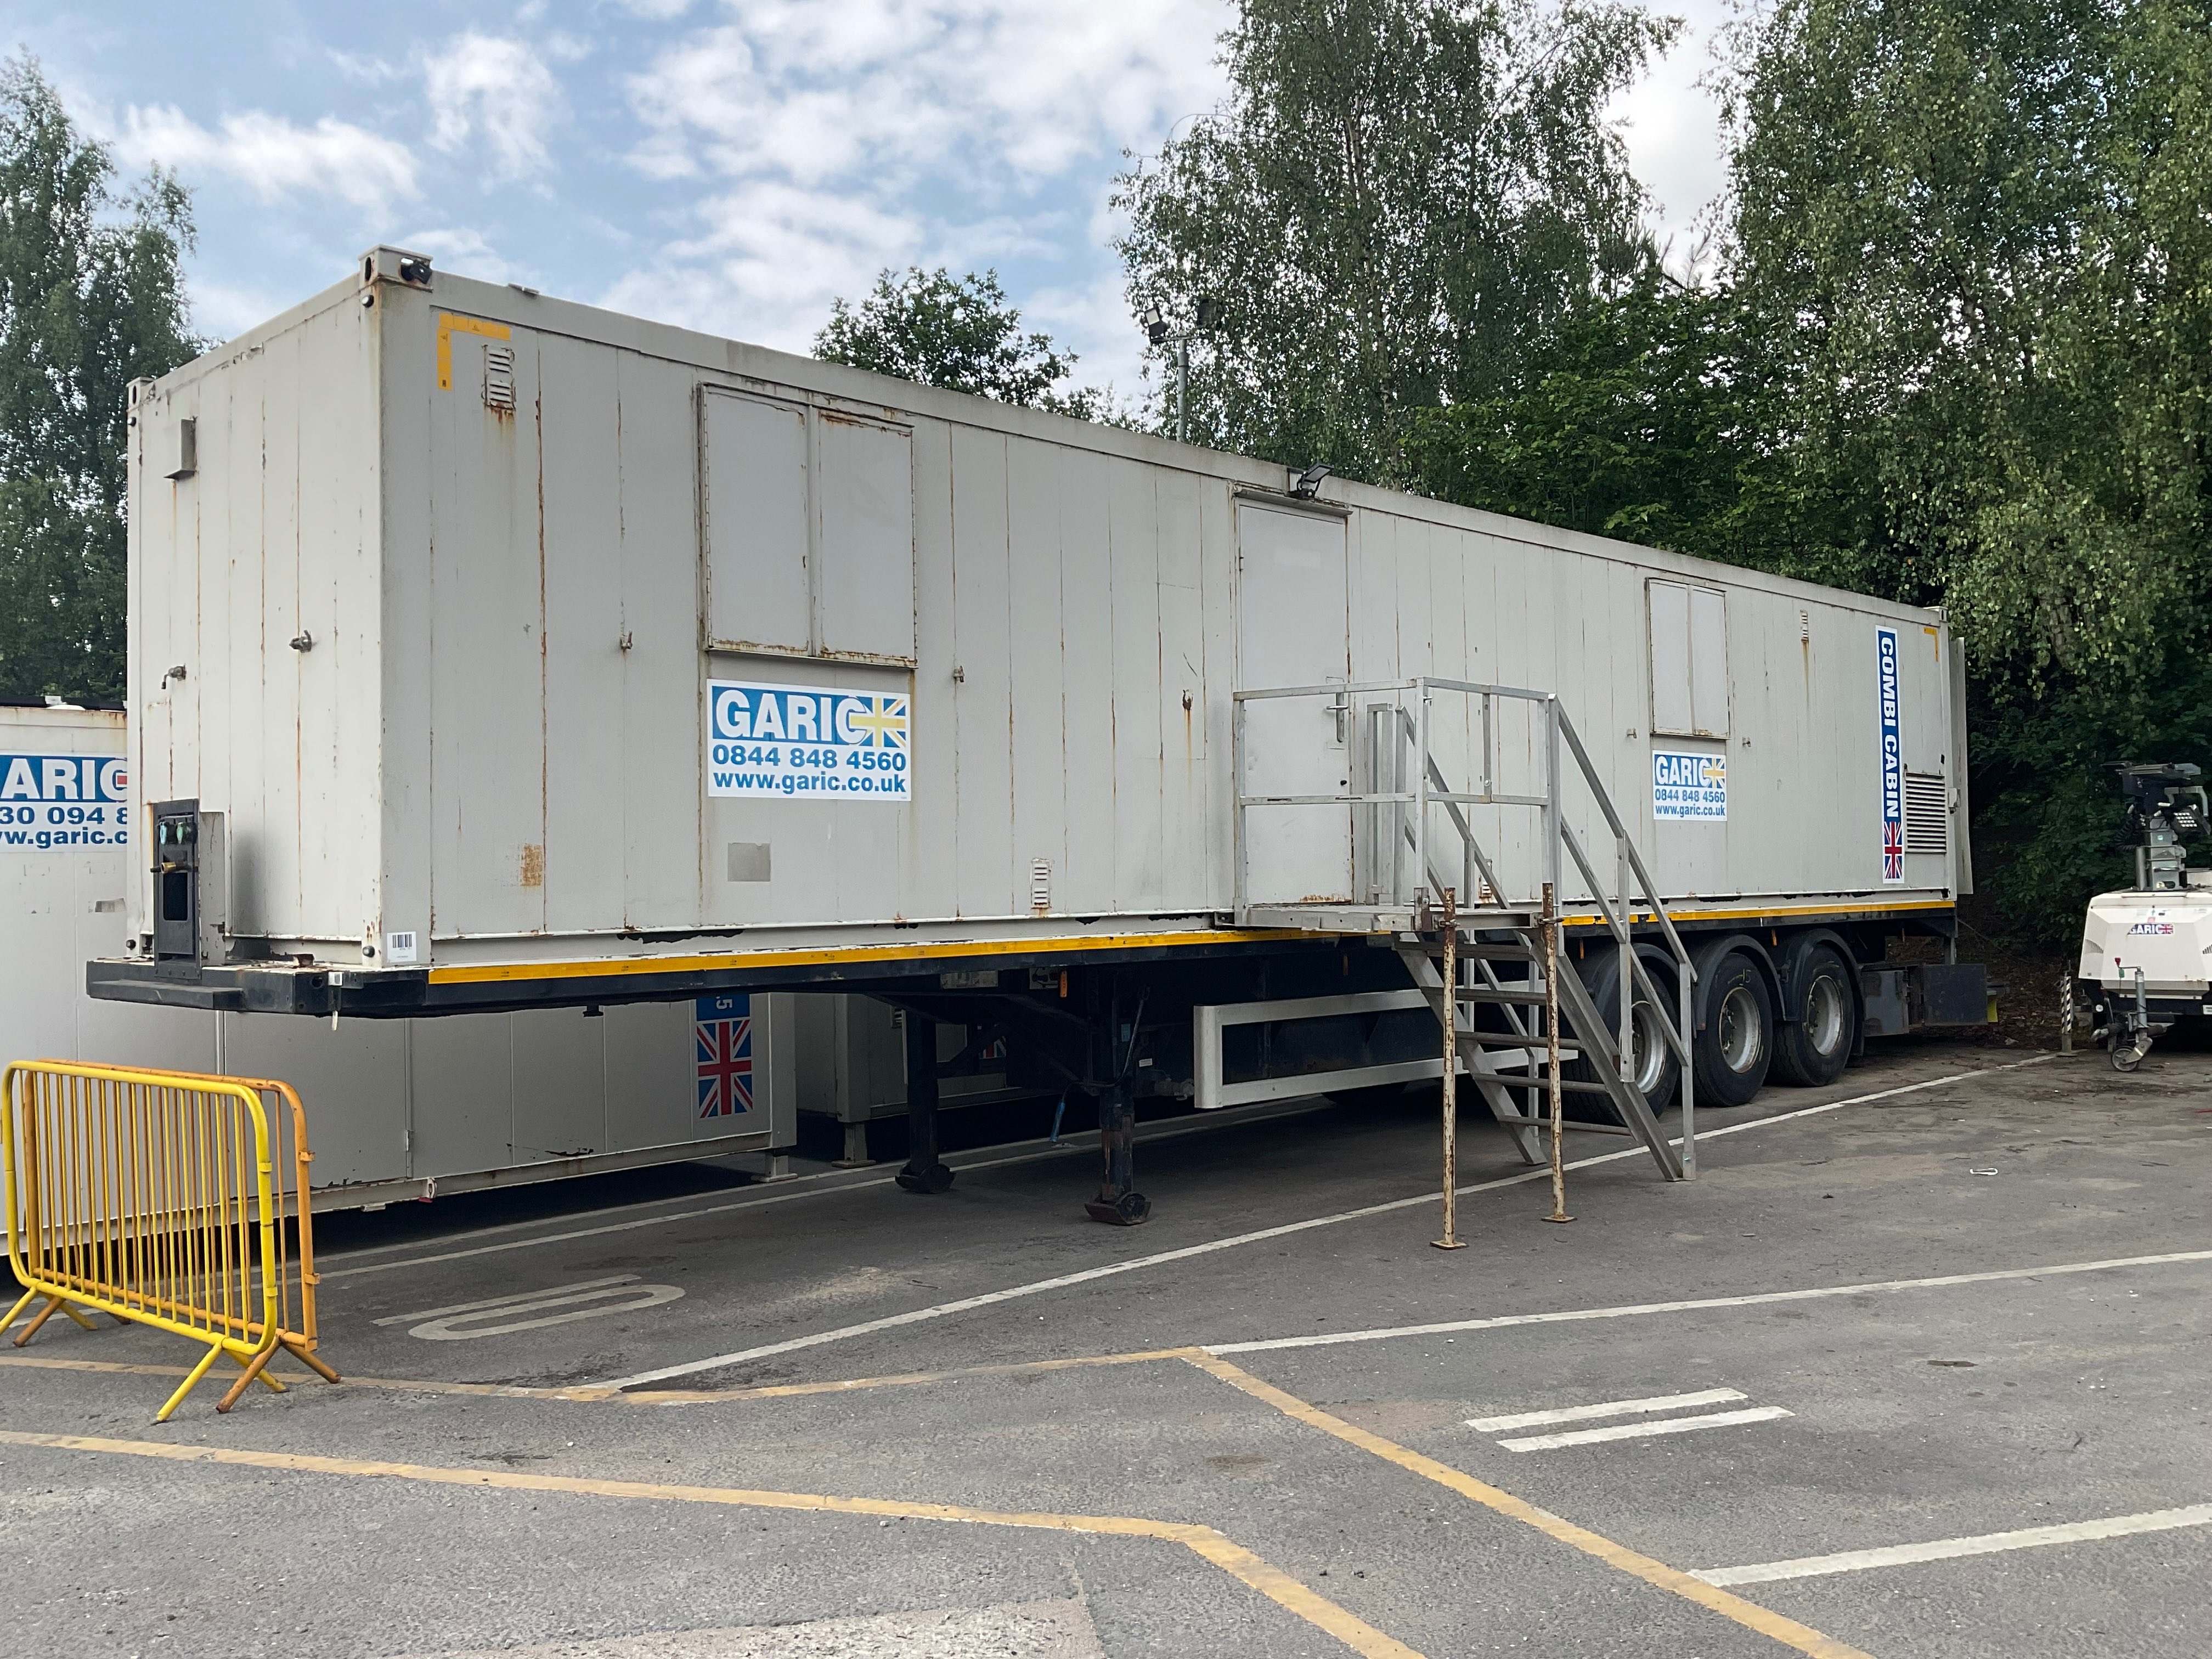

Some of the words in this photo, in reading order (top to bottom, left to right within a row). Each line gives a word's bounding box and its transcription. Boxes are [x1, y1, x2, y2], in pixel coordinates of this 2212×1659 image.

[1881, 636, 1895, 726] COMBI
[716, 690, 867, 744] GARIC
[713, 744, 780, 766] 0844
[790, 748, 837, 768] 848
[847, 751, 906, 771] 4560
[1656, 756, 1711, 786] GARIC
[713, 771, 906, 794] www.garic.co.uk
[1884, 735, 1900, 817] CABIN
[1655, 789, 1679, 801] 0844
[1682, 790, 1699, 802] 848
[1703, 791, 1725, 803] 4560
[47, 806, 105, 825] 094
[1656, 804, 1725, 817] www.garic.co.uk
